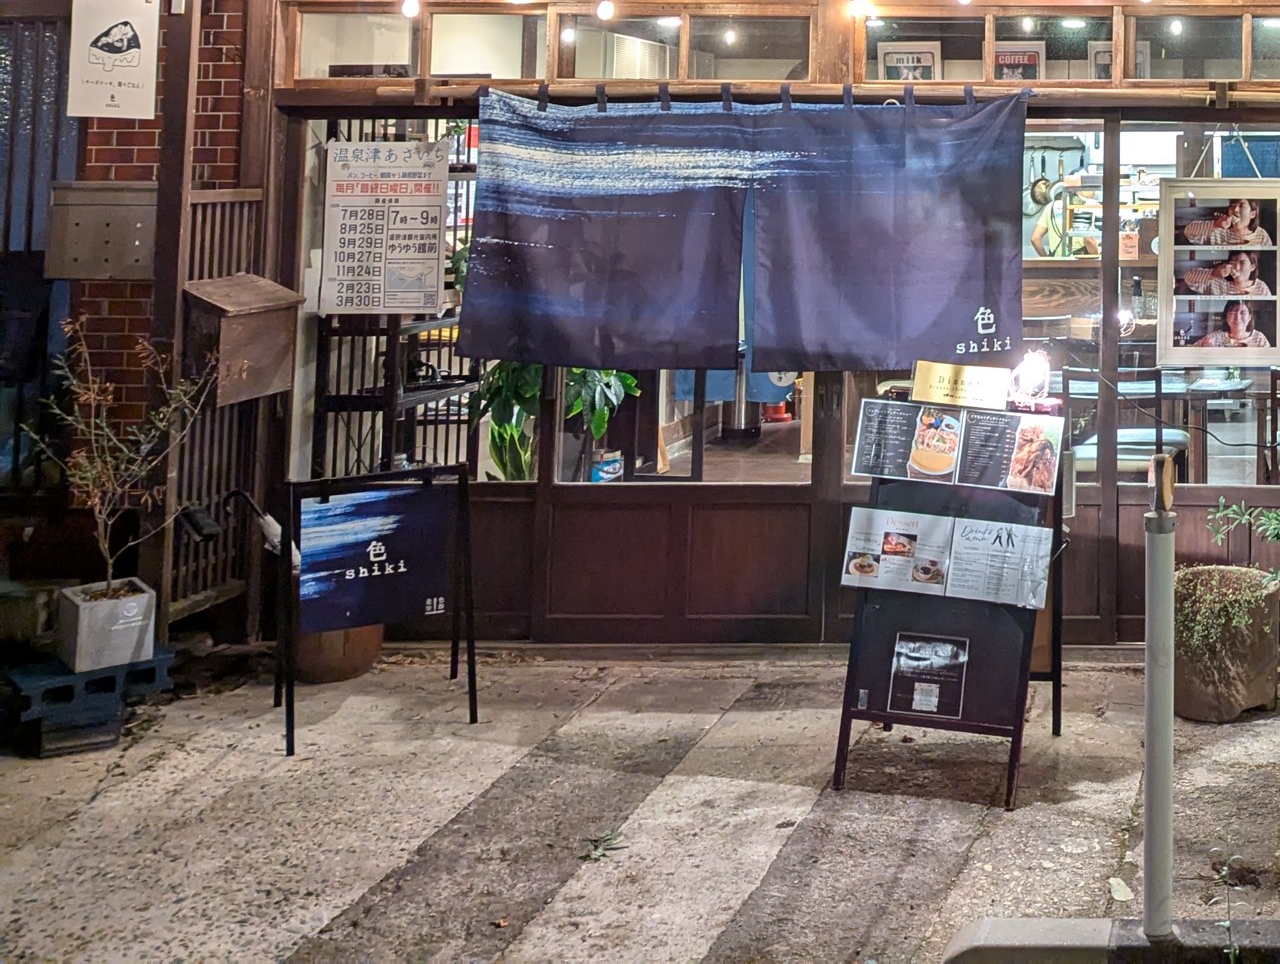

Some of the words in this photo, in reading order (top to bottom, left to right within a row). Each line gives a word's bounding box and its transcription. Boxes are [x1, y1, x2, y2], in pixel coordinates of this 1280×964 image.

[895, 56, 922, 65] milk
[998, 55, 1030, 65] COFFEE
[333, 148, 445, 163] 温泉津あさいち
[341, 209, 385, 221] 7月28日
[340, 223, 384, 235] 8月25日
[339, 237, 384, 249] 9月29日
[334, 251, 382, 263] 10月27日
[336, 265, 382, 277] 11月24日
[336, 282, 381, 294] 2月23日
[335, 295, 381, 307] 3月30日
[974, 306, 996, 335] 色
[956, 336, 1012, 354] shiki
[886, 517, 919, 528] Dessert
[960, 523, 995, 538] Drinks
[366, 540, 387, 561] 色
[345, 559, 408, 579] shiki
